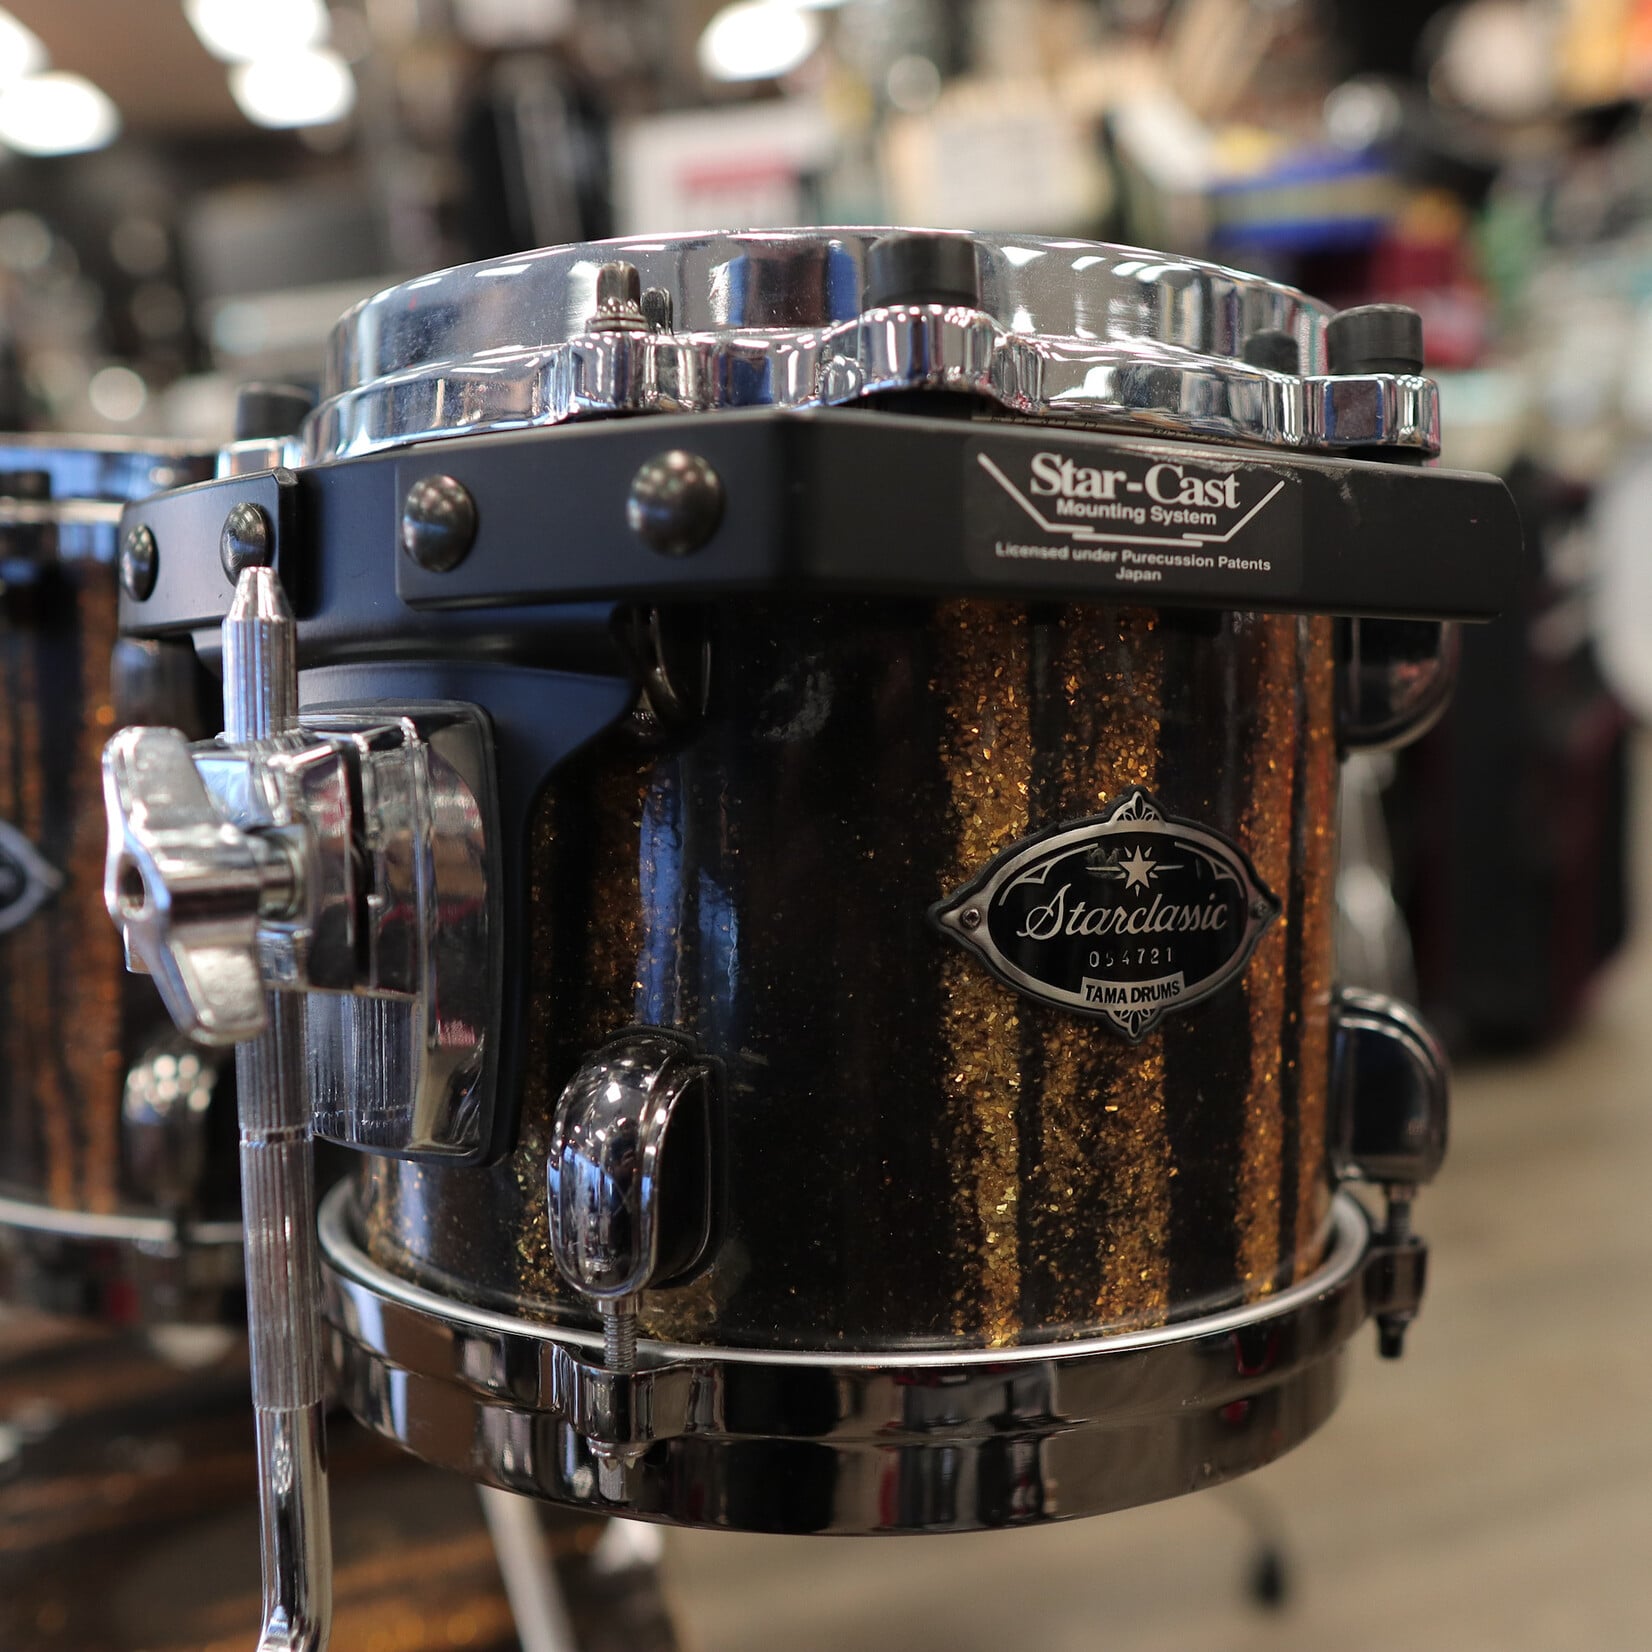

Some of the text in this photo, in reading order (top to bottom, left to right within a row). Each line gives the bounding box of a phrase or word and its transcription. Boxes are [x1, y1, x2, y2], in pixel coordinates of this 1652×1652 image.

[1030, 452, 1241, 509] Star-Cast
[1056, 499, 1217, 526] Mounting System
[995, 541, 1271, 571] Licensed under Purecussion Patents
[1115, 566, 1162, 583] Japan
[1016, 884, 1227, 940] Starclassic
[1085, 980, 1180, 1004] TAMA DRUMS
